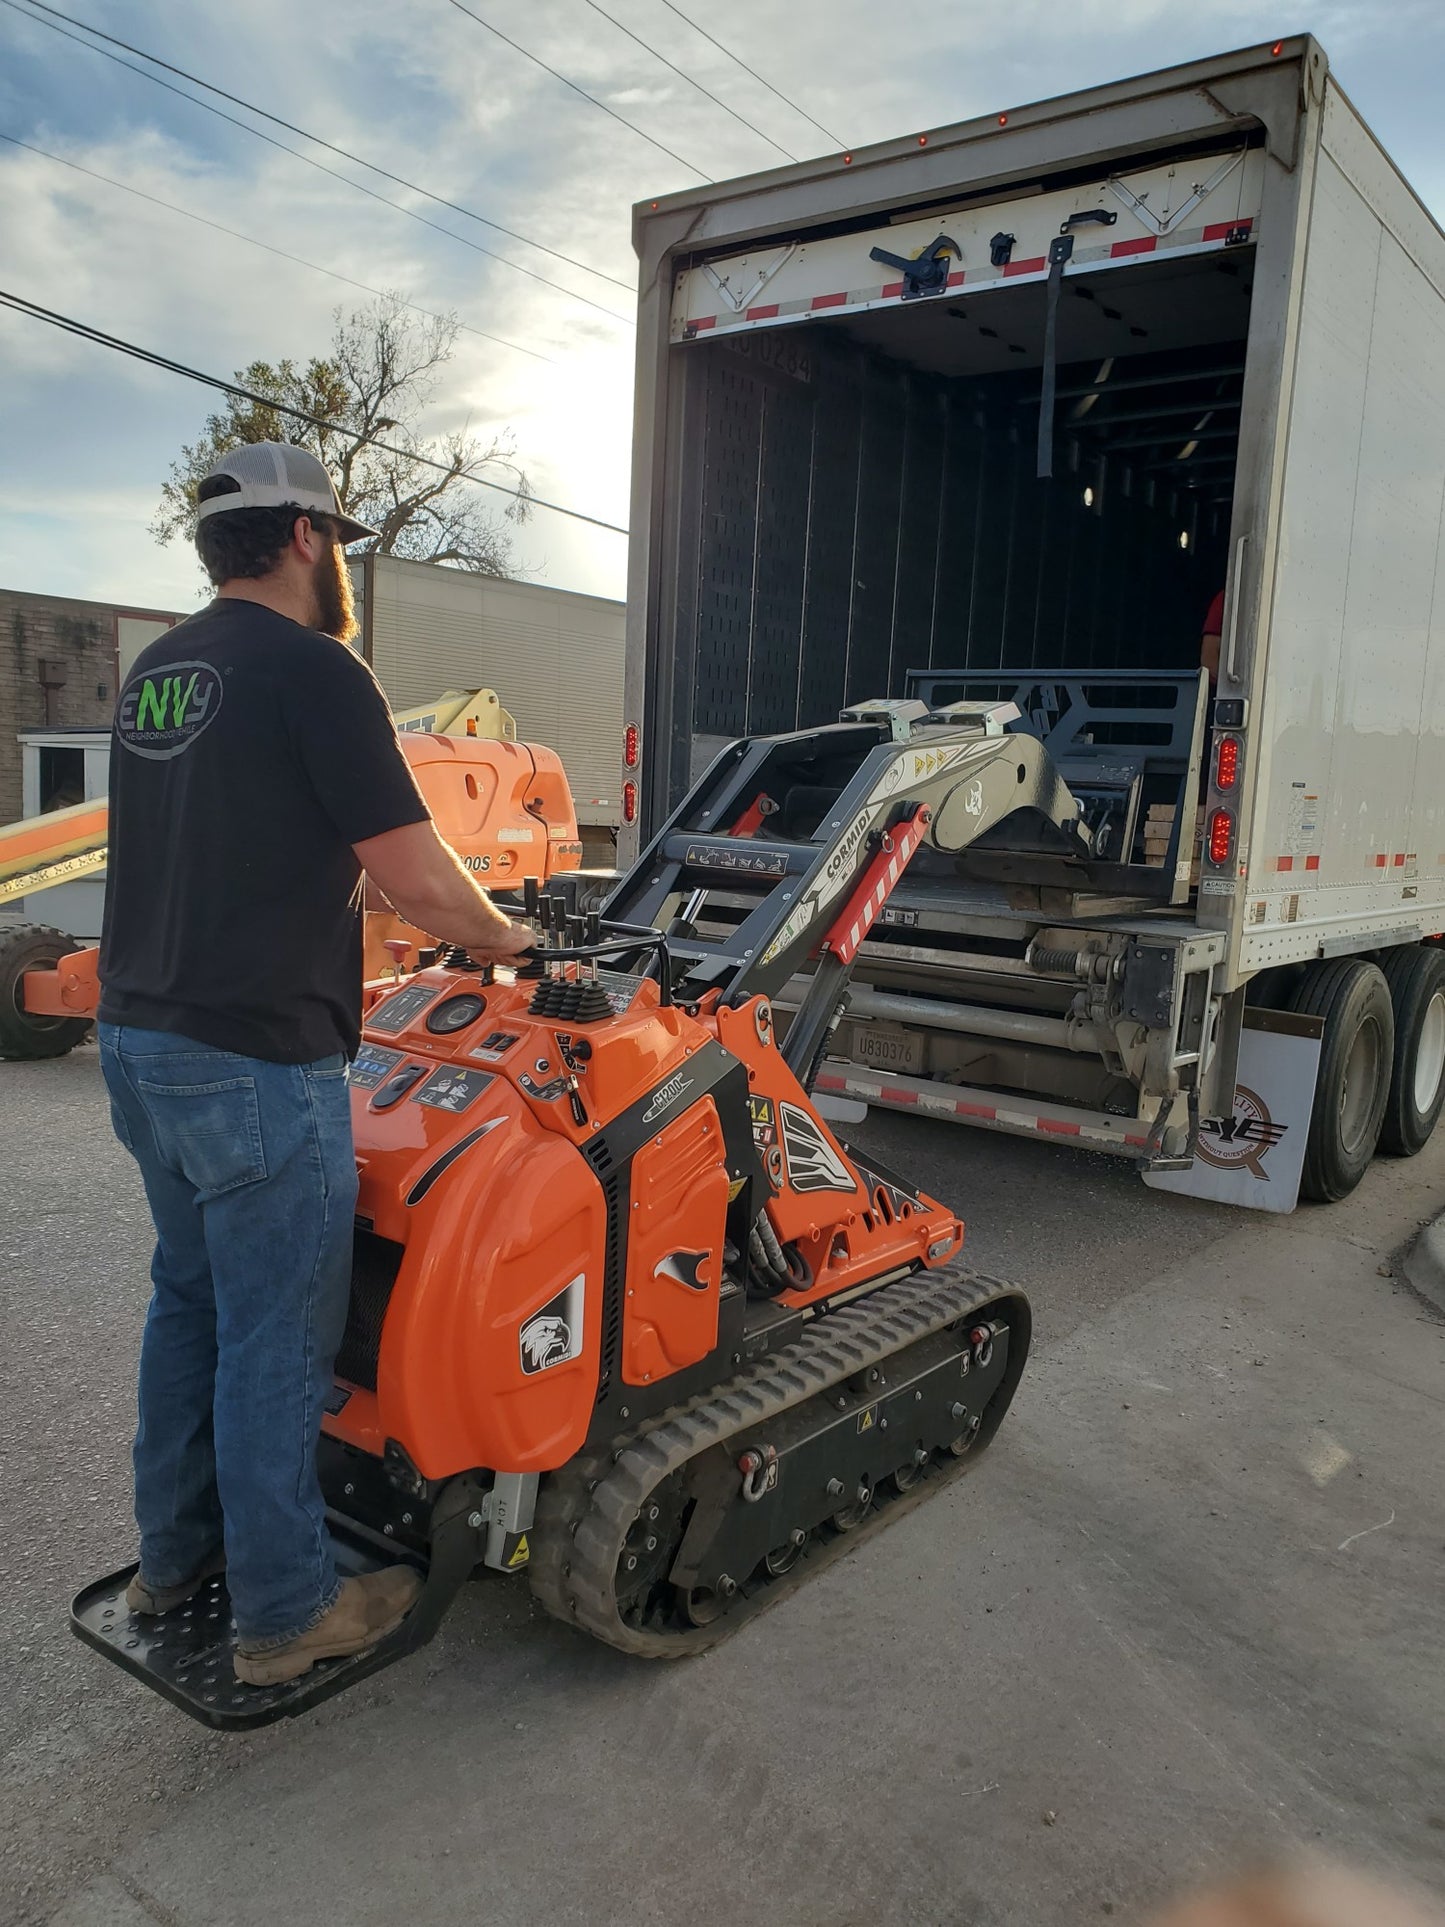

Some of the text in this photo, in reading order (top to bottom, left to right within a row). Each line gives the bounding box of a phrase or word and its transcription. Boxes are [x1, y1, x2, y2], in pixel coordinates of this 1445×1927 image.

[826, 807, 872, 879] CORMIDI
[461, 855, 491, 871] 00S
[860, 1038, 912, 1062] U830376
[653, 1078, 683, 1109] C1200
[1223, 1143, 1255, 1158] QUESTION
